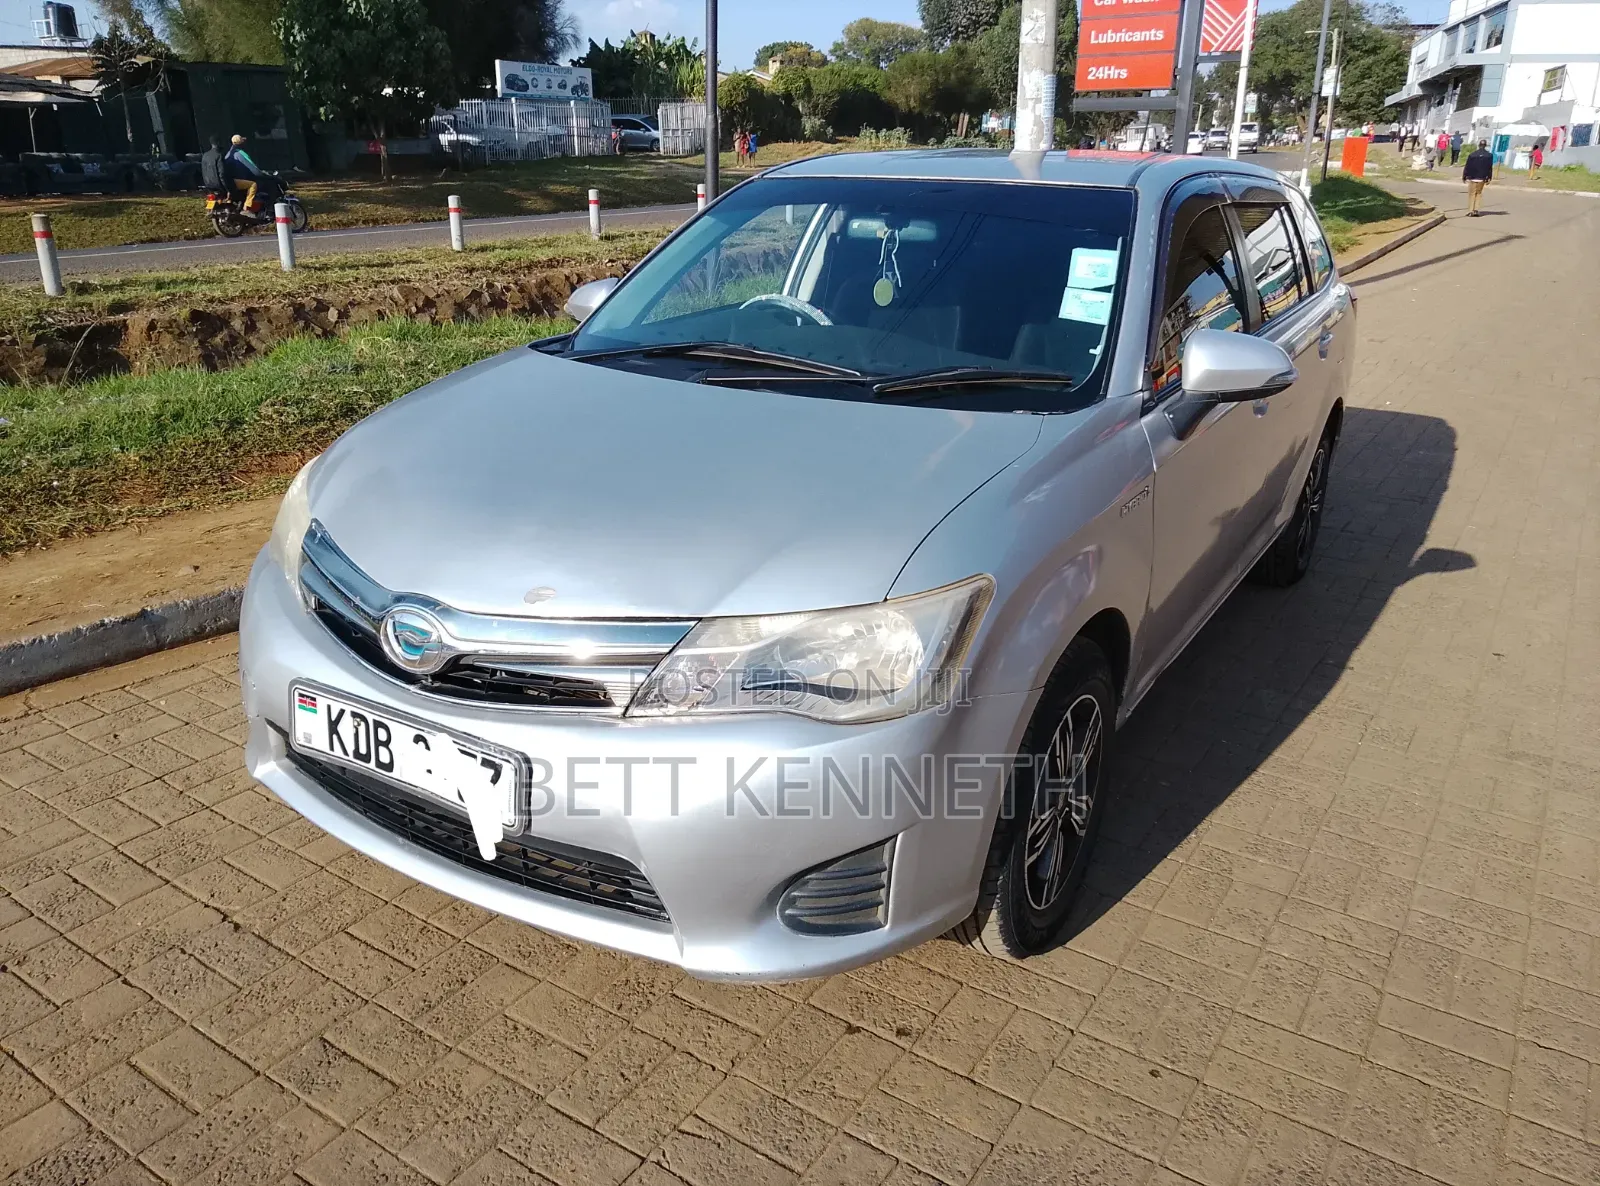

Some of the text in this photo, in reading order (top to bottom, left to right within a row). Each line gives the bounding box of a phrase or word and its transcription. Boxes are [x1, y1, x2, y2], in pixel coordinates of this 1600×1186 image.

[1090, 29, 1164, 44] Lubricants
[553, 66, 573, 75] MOTORS
[1087, 66, 1128, 80] 24Hrs
[326, 704, 395, 773] KDB
